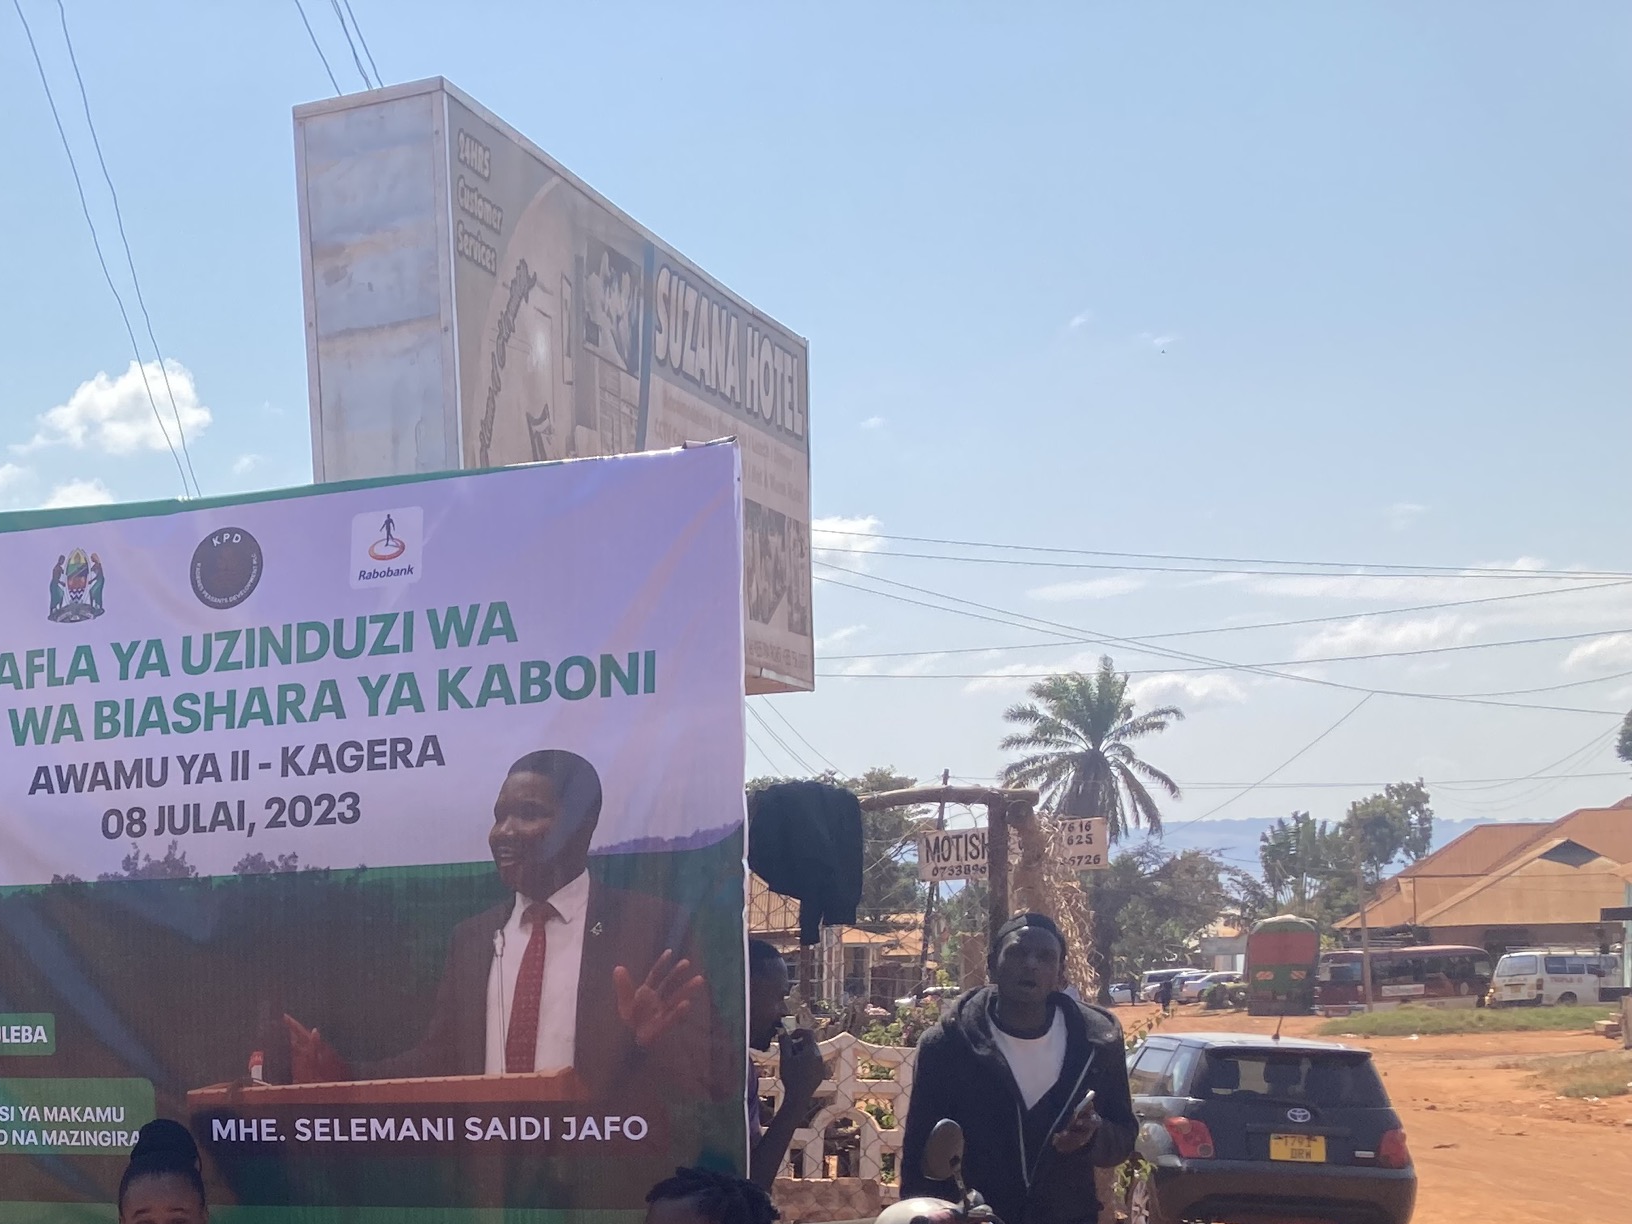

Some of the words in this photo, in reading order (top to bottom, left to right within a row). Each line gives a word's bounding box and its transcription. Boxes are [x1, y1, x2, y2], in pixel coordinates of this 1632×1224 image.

[457, 128, 491, 182] 24HRS
[457, 174, 503, 236] Customer
[456, 220, 497, 277] Services
[654, 264, 741, 402] SUZANA
[746, 322, 804, 440] HOTEL
[212, 533, 241, 547] KPD
[358, 564, 414, 582] Rabobank
[110, 639, 170, 682] YA
[181, 611, 414, 676] UZINDUZI
[426, 601, 518, 650] WA
[9, 703, 84, 748] WA
[93, 679, 346, 741] BIASHARA
[357, 672, 425, 718] YA
[437, 650, 657, 711] KABONI
[28, 756, 169, 795] AWAMU
[175, 752, 222, 786] YA
[231, 749, 250, 781] II
[280, 734, 446, 777] KAGERA
[101, 806, 147, 839] 08
[154, 800, 256, 838] JULAI,
[264, 791, 361, 829] 2023
[12, 1130, 38, 1146] NA
[42, 1130, 140, 1148] MAZINGIRA
[18, 1106, 41, 1122] YA
[43, 1107, 124, 1123] MAKAMU
[211, 1118, 286, 1142] MHE.
[295, 1117, 454, 1142] SELEMANI
[465, 1116, 550, 1141] SAIDI
[561, 1115, 649, 1141] JAFO
